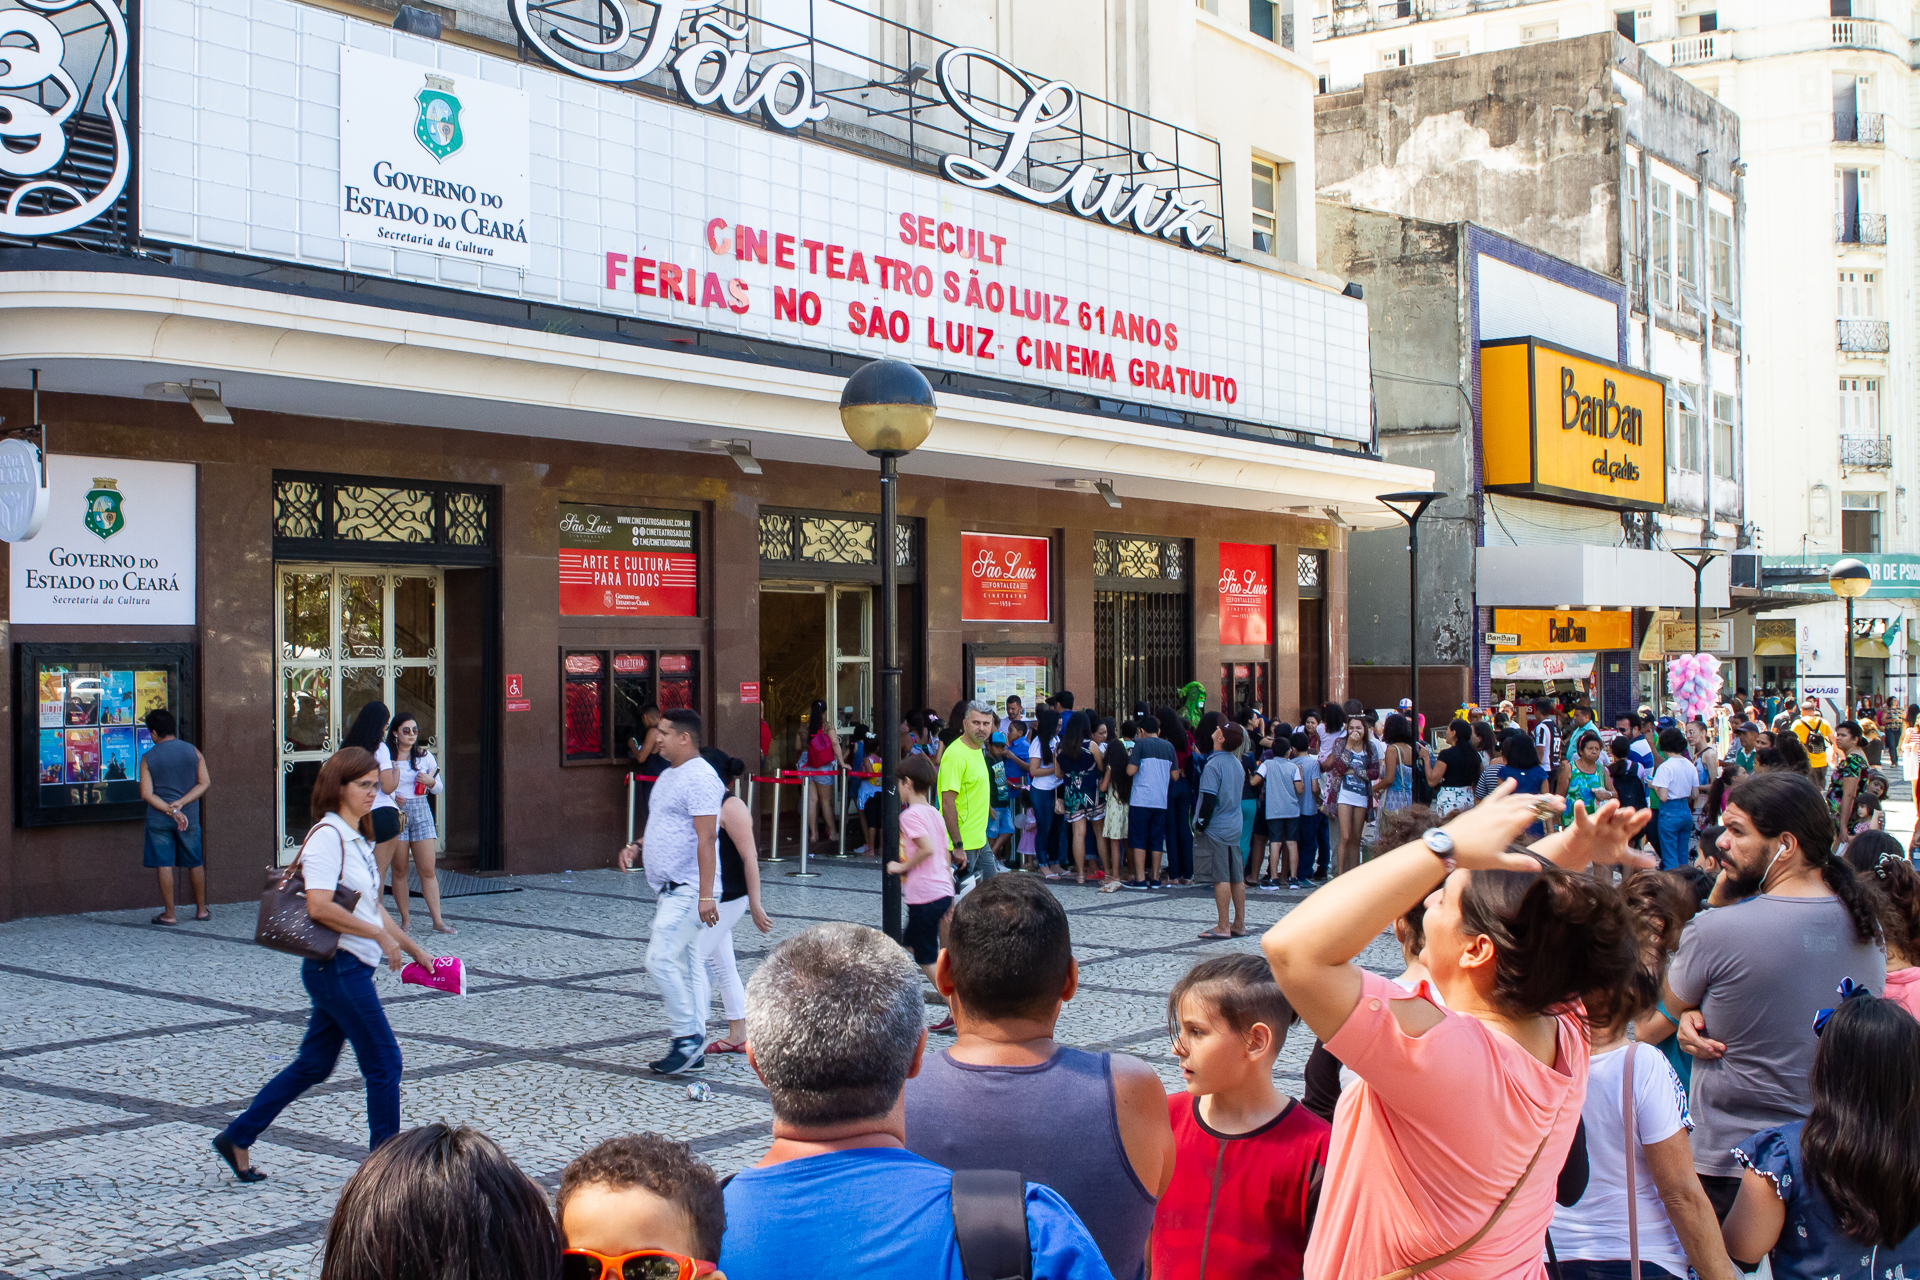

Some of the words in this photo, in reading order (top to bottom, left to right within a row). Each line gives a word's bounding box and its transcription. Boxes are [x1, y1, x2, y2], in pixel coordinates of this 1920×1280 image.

[935, 46, 1215, 247] Luiz
[373, 161, 476, 204] GOVERNO
[480, 192, 503, 209] DO
[344, 185, 429, 225] ESTADO
[433, 213, 457, 230] DO
[461, 208, 528, 244] CEARÁ
[377, 226, 433, 246] Secretaria
[438, 236, 450, 249] da
[455, 240, 494, 257] Cultura
[899, 212, 1006, 266] SECULT
[606, 245, 750, 314] FÉRIAS
[774, 285, 822, 326] NO
[848, 296, 910, 344] SÃO
[1016, 335, 1117, 383] CINEMA
[1128, 357, 1237, 405] GRATUITO
[1561, 366, 1643, 446] BanBan
[1592, 449, 1640, 483] calçados
[560, 513, 585, 533] São
[586, 514, 613, 534] Luiz
[49, 546, 136, 569] GOVERNO
[139, 558, 159, 569] DO
[582, 554, 609, 570] ARTE
[614, 556, 620, 570] E
[624, 556, 671, 572] CULTURA
[971, 549, 1002, 578] São
[1003, 550, 1037, 580] Luiz
[25, 568, 95, 590] ESTADO
[99, 579, 118, 590] DO
[122, 571, 180, 591] CEARÁ
[594, 571, 622, 586] PARA
[626, 572, 660, 587] TODOS
[1218, 568, 1242, 594] São
[1242, 569, 1268, 595] Luiz
[1883, 563, 1897, 580] DE
[52, 595, 99, 605] Secretaria
[102, 595, 114, 605] da
[117, 596, 151, 605] Cultura
[1487, 633, 1516, 642] BanBan
[1550, 617, 1586, 643] BanBan
[615, 657, 645, 668] BILHETERIA
